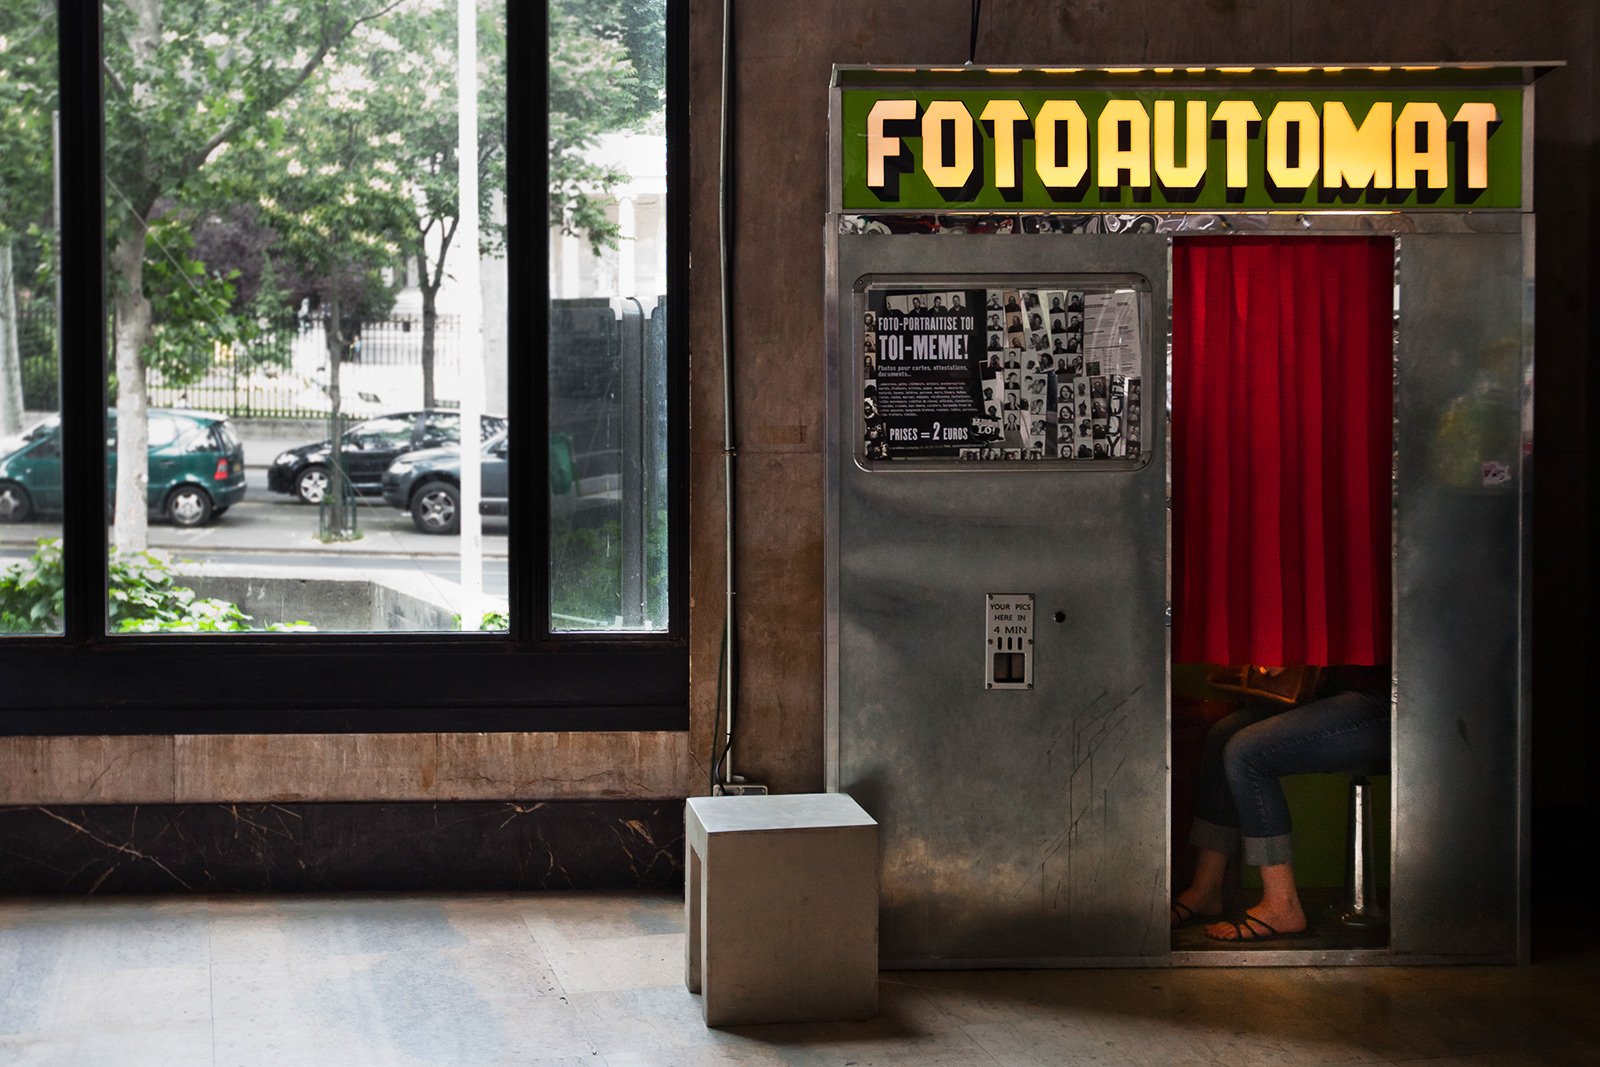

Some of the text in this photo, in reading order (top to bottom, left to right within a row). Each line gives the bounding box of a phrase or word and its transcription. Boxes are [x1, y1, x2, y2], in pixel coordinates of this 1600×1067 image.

[866, 99, 1497, 190] FOTOAUTOMAT
[878, 316, 974, 331] FOTO-PORTRAITISE TOI
[879, 334, 969, 361] TOI-MEME!
[889, 428, 918, 441] PRISES
[932, 421, 941, 441] 2
[943, 427, 968, 440] EUROS
[990, 603, 1031, 611] YOUR PICS
[993, 625, 1027, 634] 4 MIN
